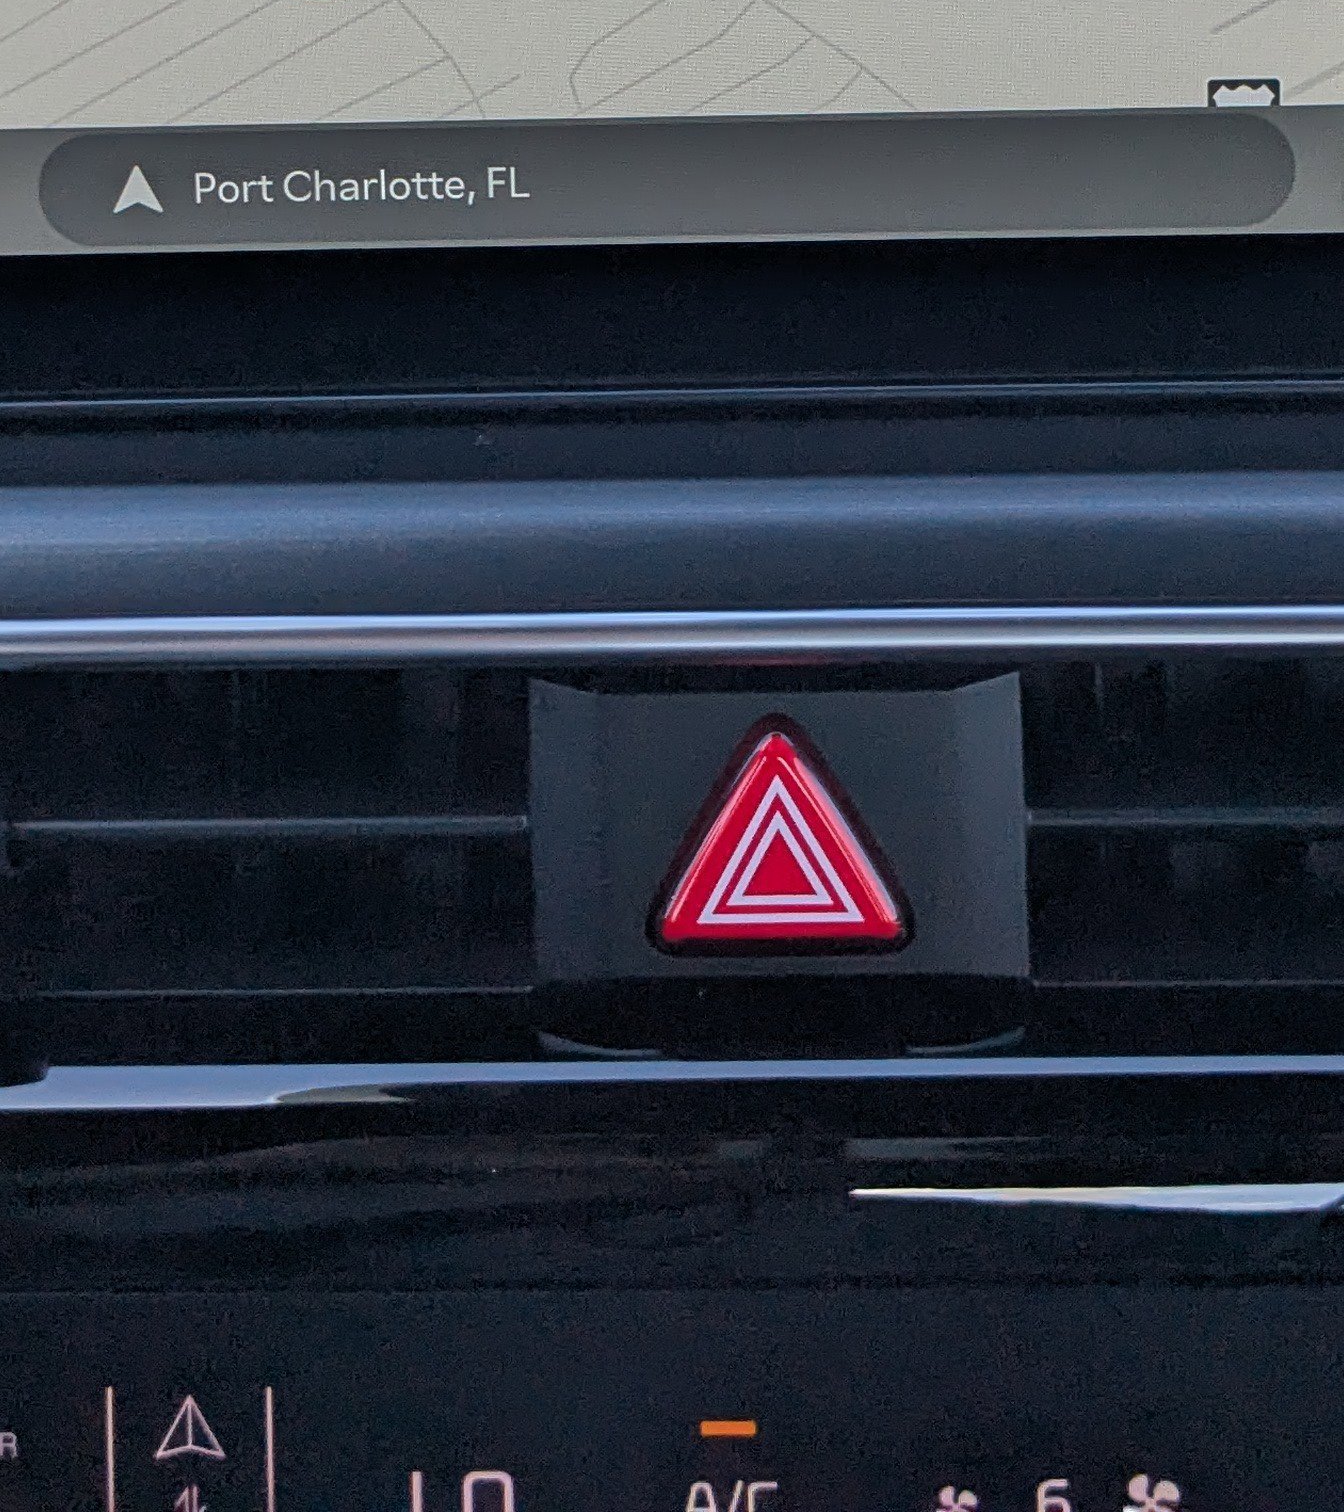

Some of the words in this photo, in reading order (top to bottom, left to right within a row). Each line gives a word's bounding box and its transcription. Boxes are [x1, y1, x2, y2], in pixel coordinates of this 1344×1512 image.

[193, 172, 274, 205] Port
[282, 168, 476, 205] Charlotte,
[488, 167, 531, 199] FL
